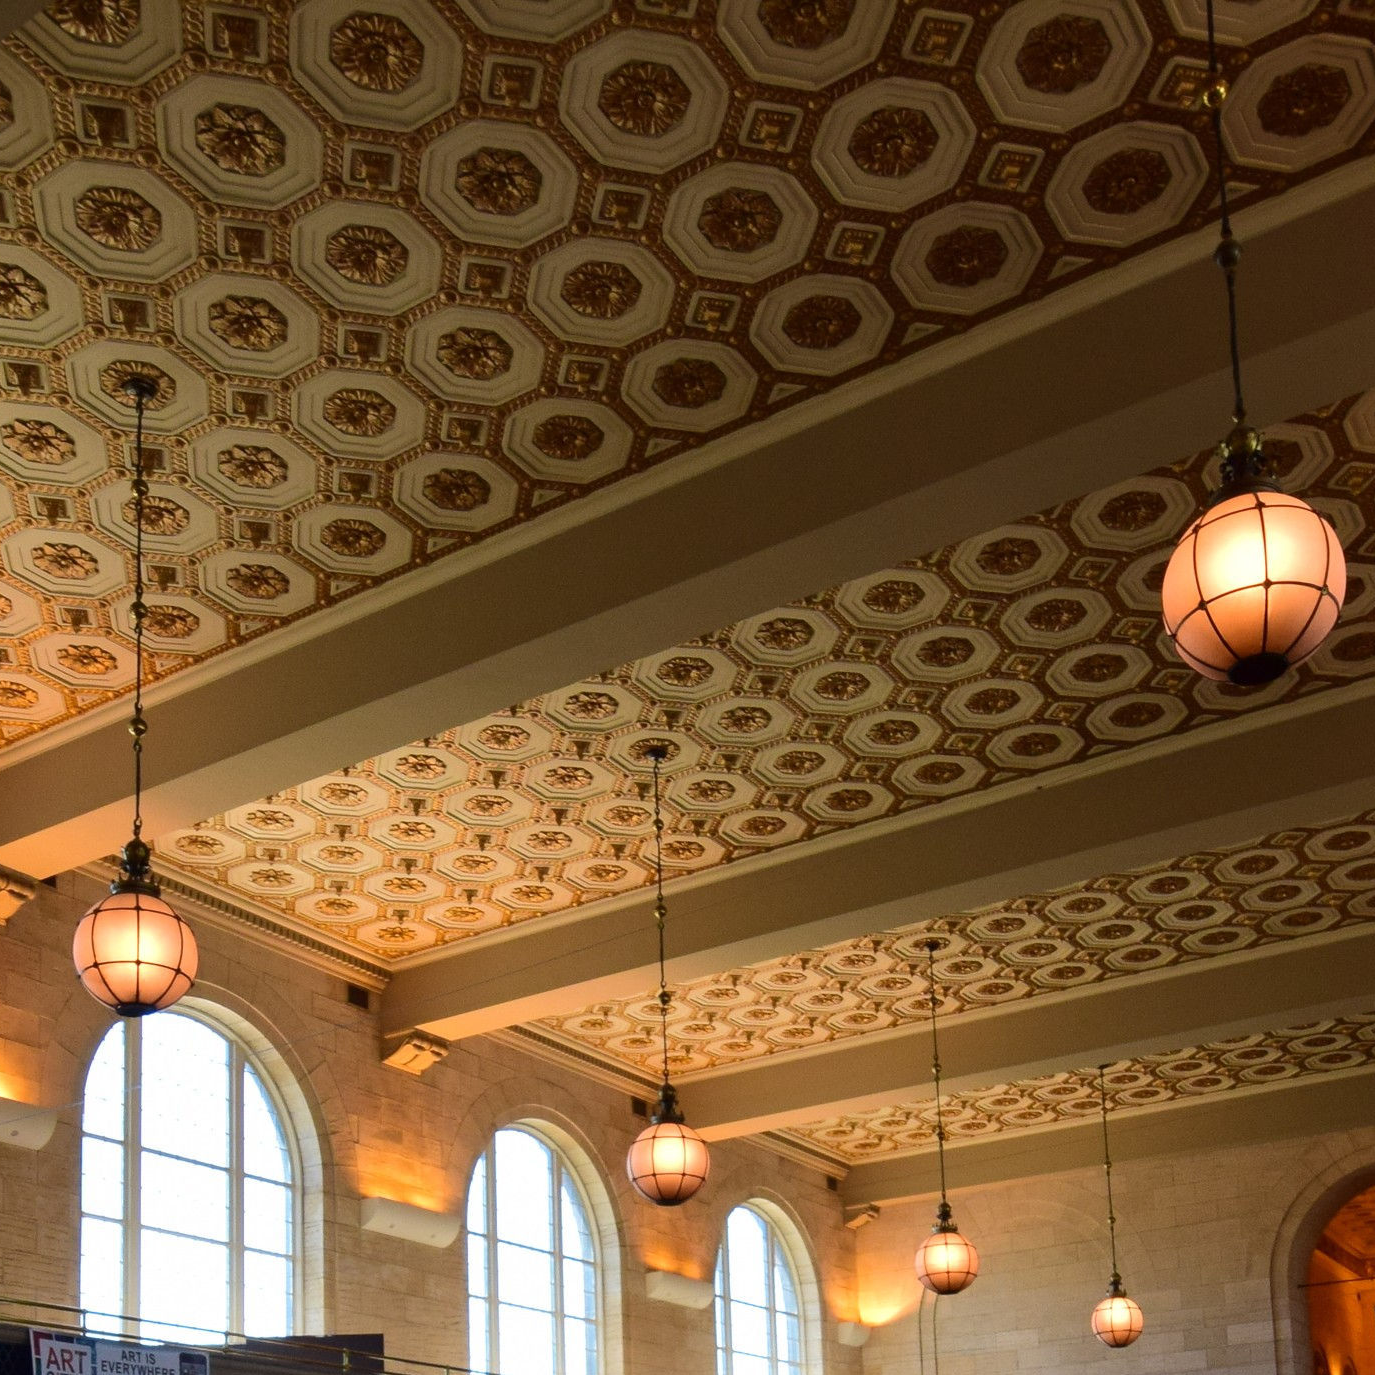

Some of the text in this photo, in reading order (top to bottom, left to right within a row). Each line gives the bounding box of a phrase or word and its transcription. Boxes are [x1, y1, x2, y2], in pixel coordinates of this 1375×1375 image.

[46, 1347, 87, 1375] ART
[121, 1350, 156, 1365] ART IS
